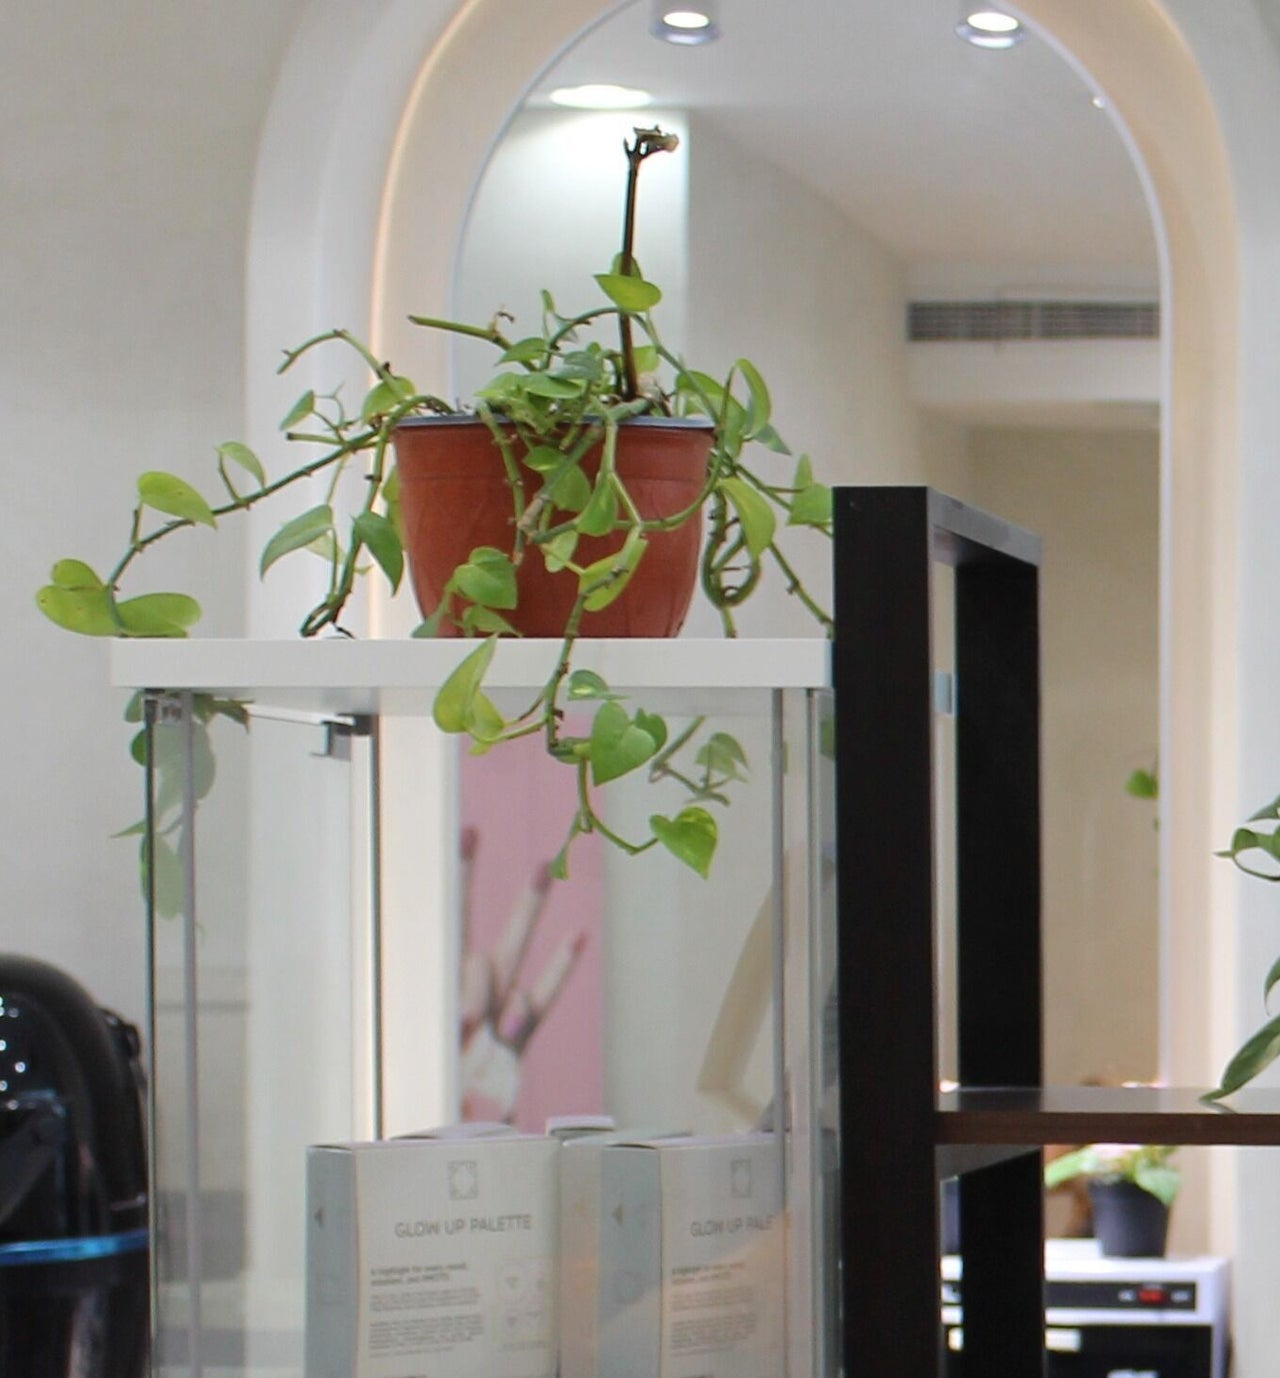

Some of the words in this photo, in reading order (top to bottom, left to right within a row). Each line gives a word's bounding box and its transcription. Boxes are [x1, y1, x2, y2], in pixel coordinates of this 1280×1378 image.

[394, 1221, 439, 1239] GLOW
[444, 1218, 465, 1236] UP
[470, 1213, 532, 1233] PALETTE
